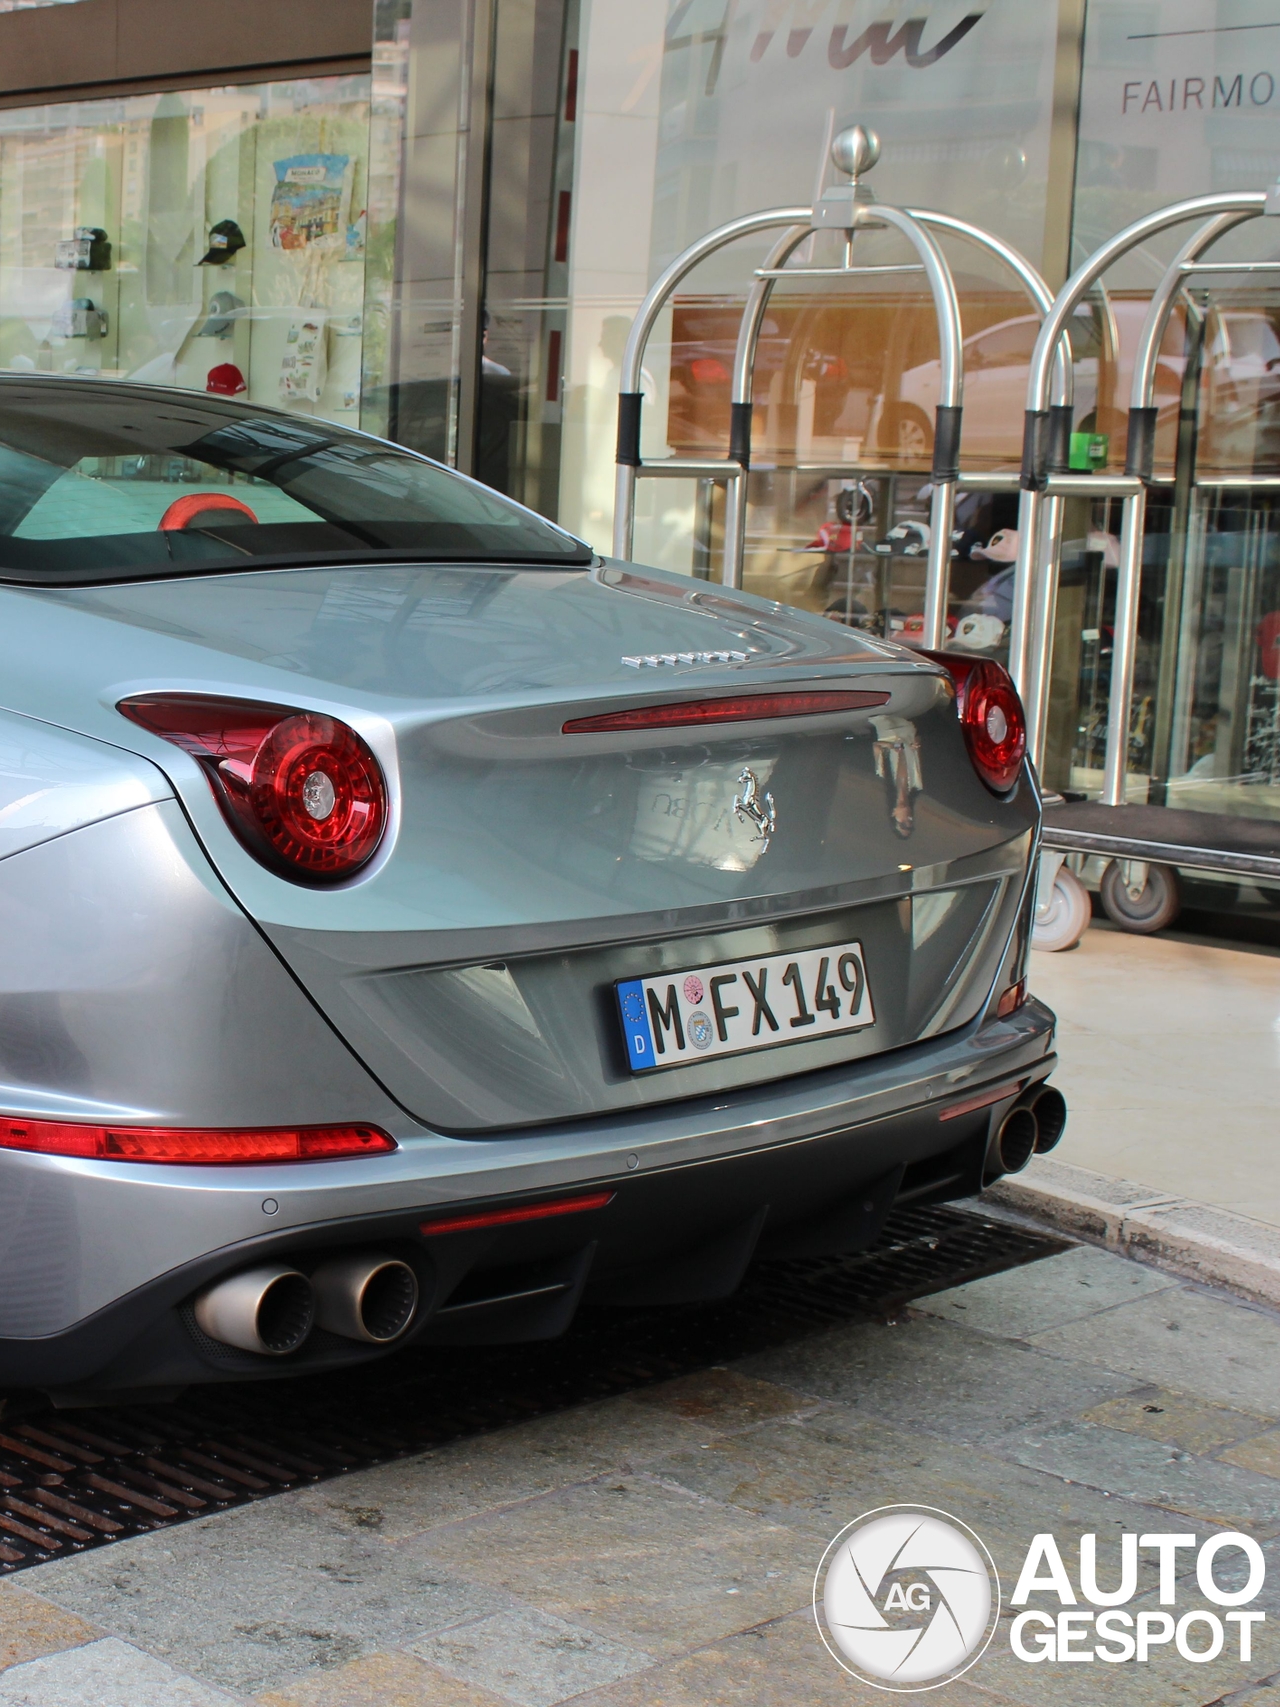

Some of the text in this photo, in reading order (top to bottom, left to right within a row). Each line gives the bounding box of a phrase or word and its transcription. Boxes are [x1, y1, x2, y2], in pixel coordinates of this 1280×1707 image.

[1121, 71, 1275, 115] FAIRMO
[646, 984, 686, 1054] M
[634, 1034, 645, 1054] D
